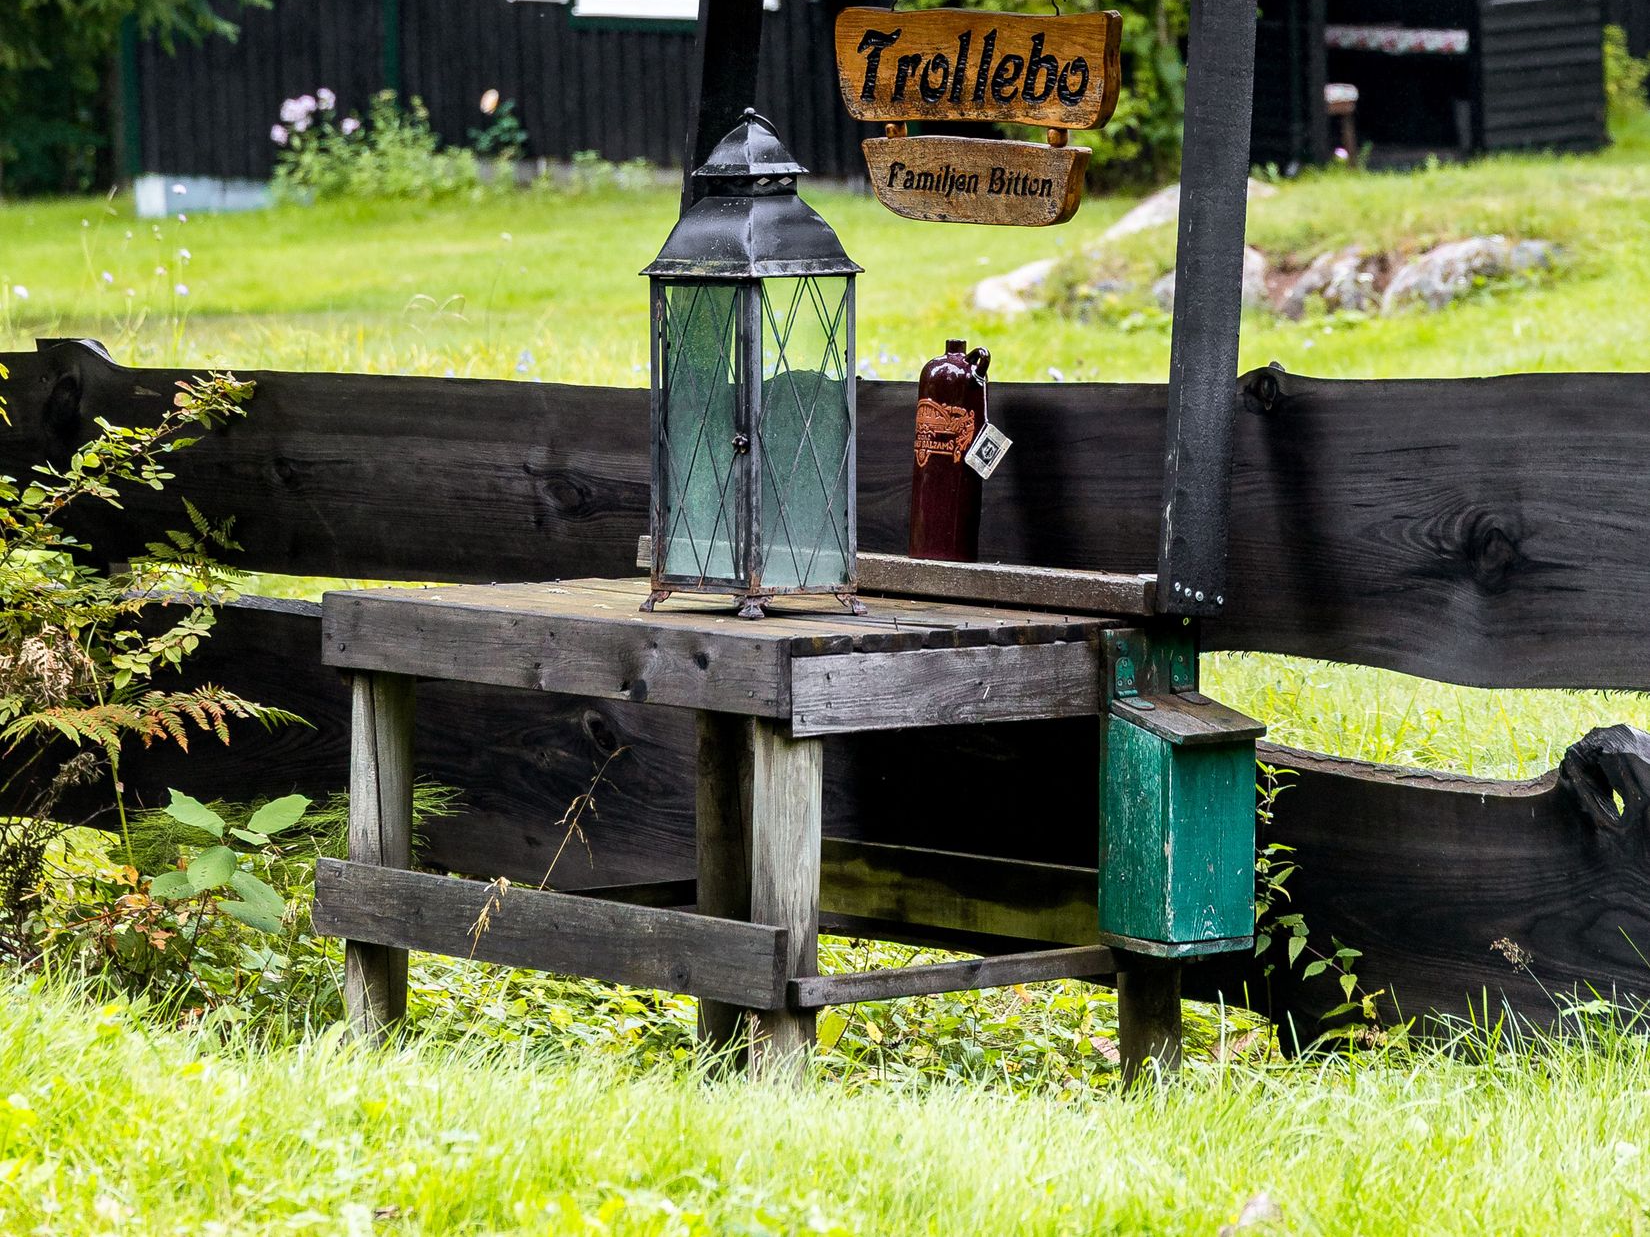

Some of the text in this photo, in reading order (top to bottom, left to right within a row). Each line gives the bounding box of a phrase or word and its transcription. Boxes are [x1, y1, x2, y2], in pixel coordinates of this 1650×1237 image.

[857, 28, 1089, 106] Trollebo
[887, 162, 1053, 197] Familjen Bitton
